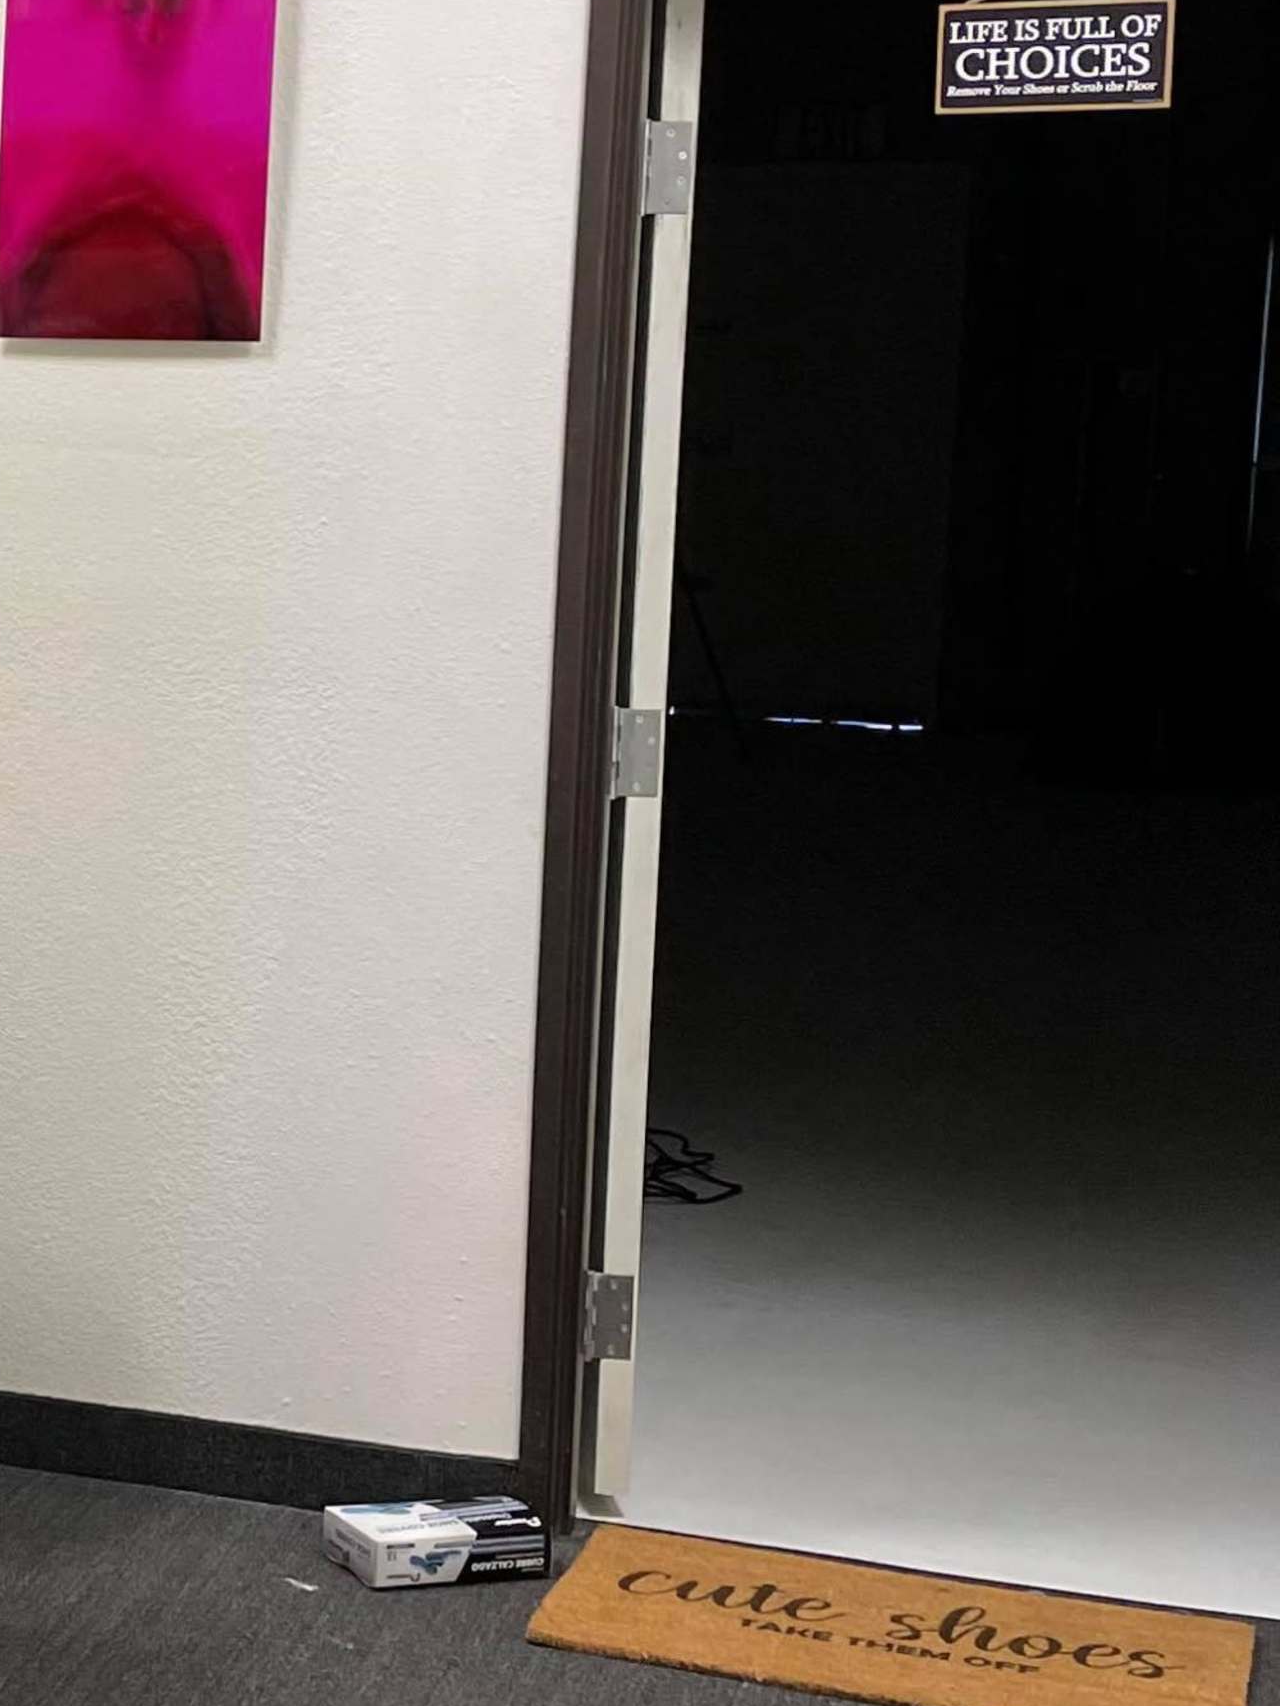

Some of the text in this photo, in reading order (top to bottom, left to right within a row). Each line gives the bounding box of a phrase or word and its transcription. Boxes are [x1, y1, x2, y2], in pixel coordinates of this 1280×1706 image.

[949, 14, 1162, 43] LIFE IS FULL OF
[955, 43, 1151, 81] CHOICES
[994, 84, 1021, 95] Your
[1022, 82, 1055, 94] Shoes
[1071, 81, 1103, 94] Scrub
[1105, 81, 1124, 92] the
[1126, 80, 1158, 91] Floor
[618, 1569, 1184, 1679] cute shoes
[740, 1618, 1042, 1676] TAKE THEM OFF
